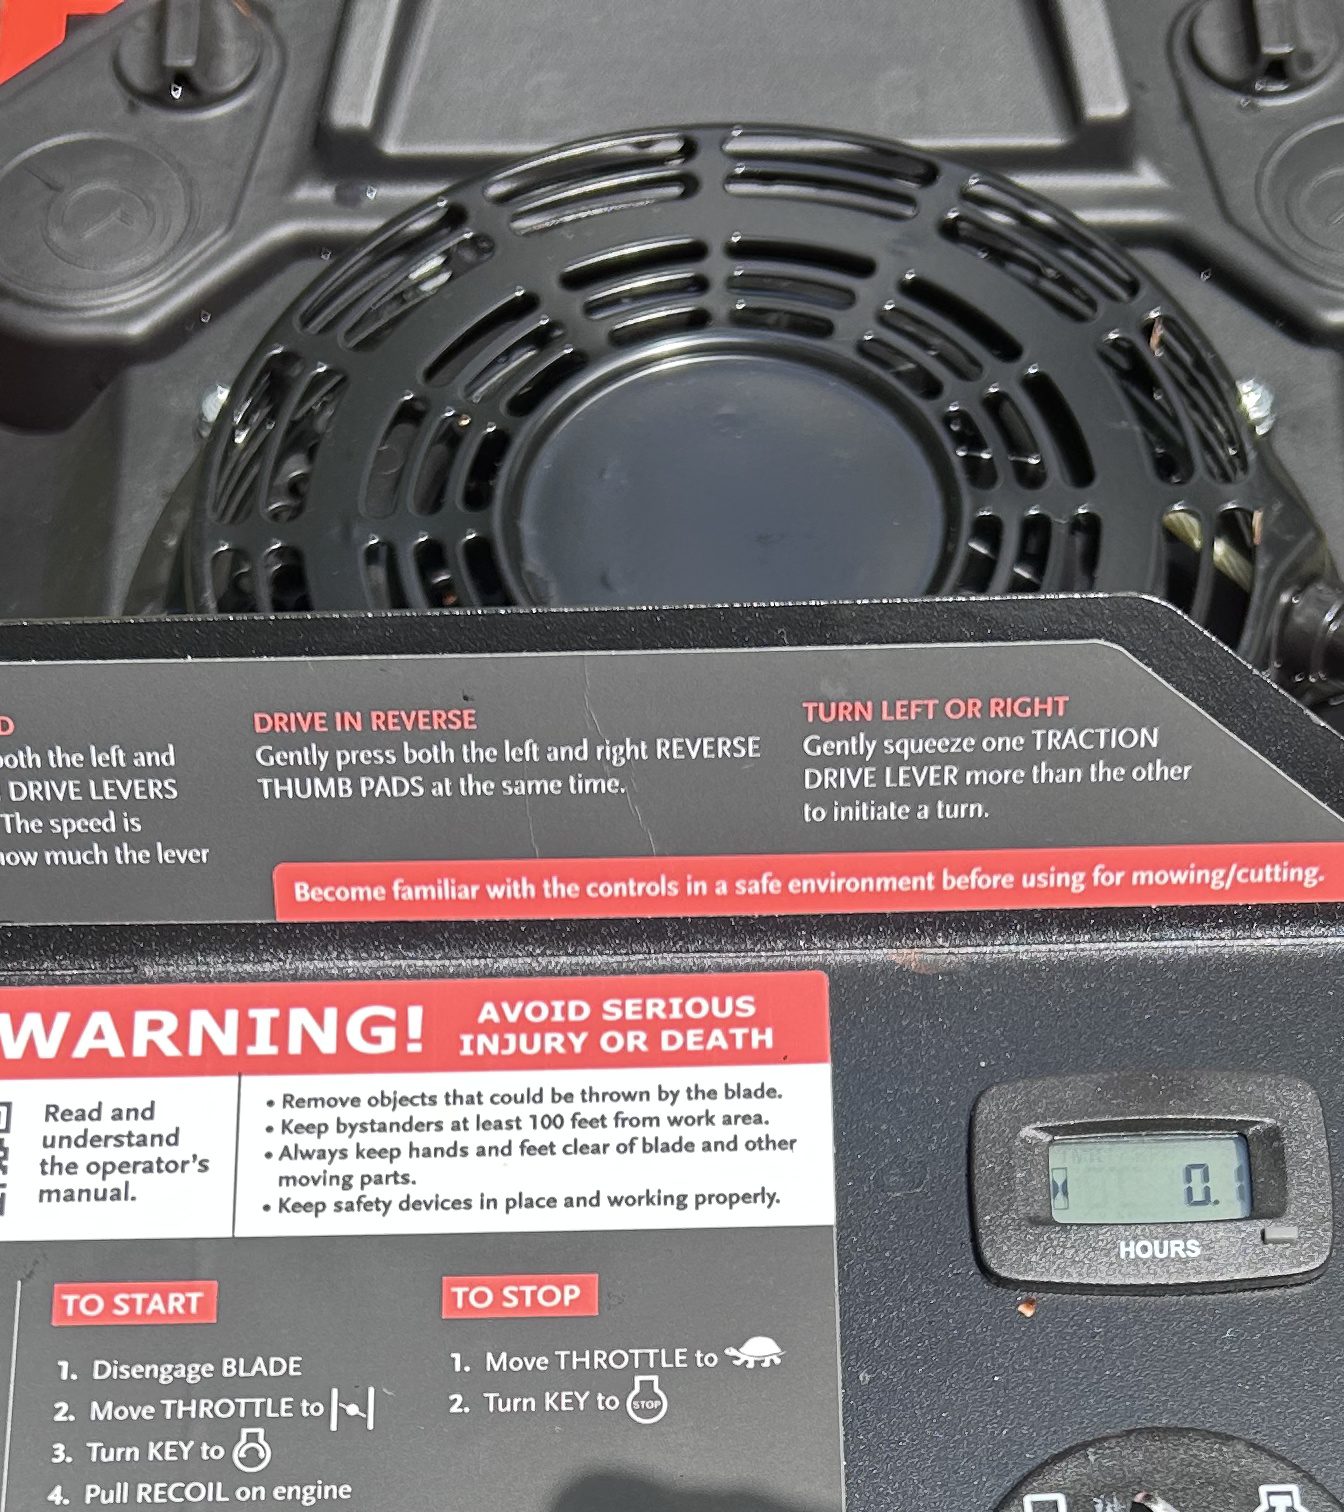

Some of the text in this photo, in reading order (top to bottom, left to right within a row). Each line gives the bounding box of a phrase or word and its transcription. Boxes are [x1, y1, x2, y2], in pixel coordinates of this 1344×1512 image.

[254, 710, 474, 732] DRIVE IN REVERSE
[804, 696, 1068, 722] TURN LEFT OR RIGHT
[48, 746, 84, 768] the
[90, 745, 126, 767] left
[134, 744, 175, 766] and
[804, 728, 1158, 761] Gently squeeze one TRACTION
[9, 780, 82, 801] DRIVE
[90, 779, 177, 799] LEVERS
[257, 774, 625, 798] THUMB PADS at the same time.
[0, 812, 43, 833] The
[50, 810, 115, 839] speed
[123, 812, 141, 832] is
[295, 862, 1324, 901] Become familiar with the controls in a safe environment before using for mowing/cutting.
[478, 996, 756, 1023] AVOID SERIOUS
[460, 1028, 773, 1055] INJURY OR DEATH
[283, 1082, 782, 1111] Remove objects that could be thrown by the blade.
[45, 1100, 155, 1122] Read and
[282, 1109, 769, 1139] Keep bystanders at least 100 feet from work area.
[43, 1127, 179, 1148] understand
[40, 1155, 78, 1175] the
[39, 1181, 136, 1203] manual.
[279, 1186, 780, 1218] Keep safety devices in place and working properly.
[1119, 1239, 1202, 1260] HOURS
[62, 1292, 204, 1316] TO START
[451, 1285, 580, 1308] TO STOP
[58, 1357, 302, 1384] 1. Disengage BLADE
[451, 1348, 718, 1372] 1. Move THROTTLE to
[54, 1398, 324, 1421] 2. Move THROTTLE to
[449, 1391, 662, 1413] 2. Turn KEY to STOP
[47, 1480, 352, 1506] 4. Pull RECOIL on engine
